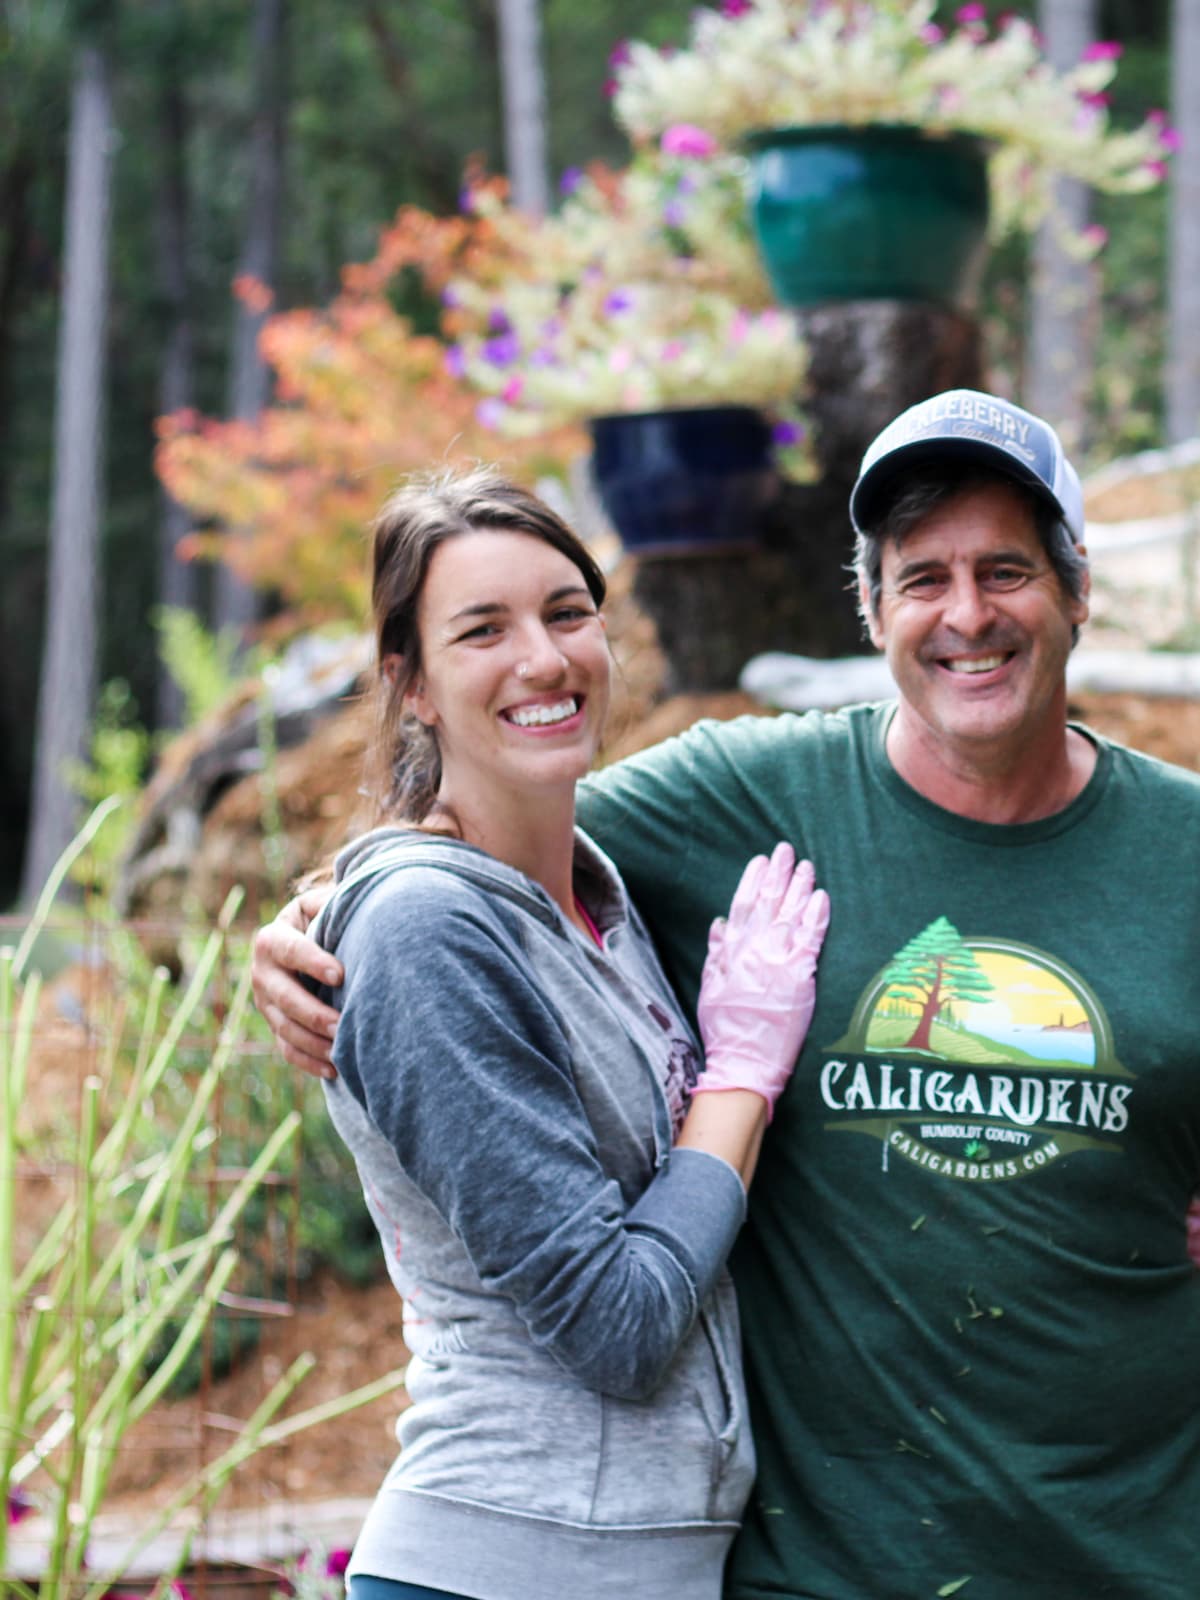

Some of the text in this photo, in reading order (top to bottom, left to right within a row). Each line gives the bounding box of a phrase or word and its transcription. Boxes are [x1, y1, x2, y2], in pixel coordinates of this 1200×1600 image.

[820, 1060, 1133, 1132] CALIGARDENS
[920, 1125, 1032, 1146] HUMBOLDT COUNTY
